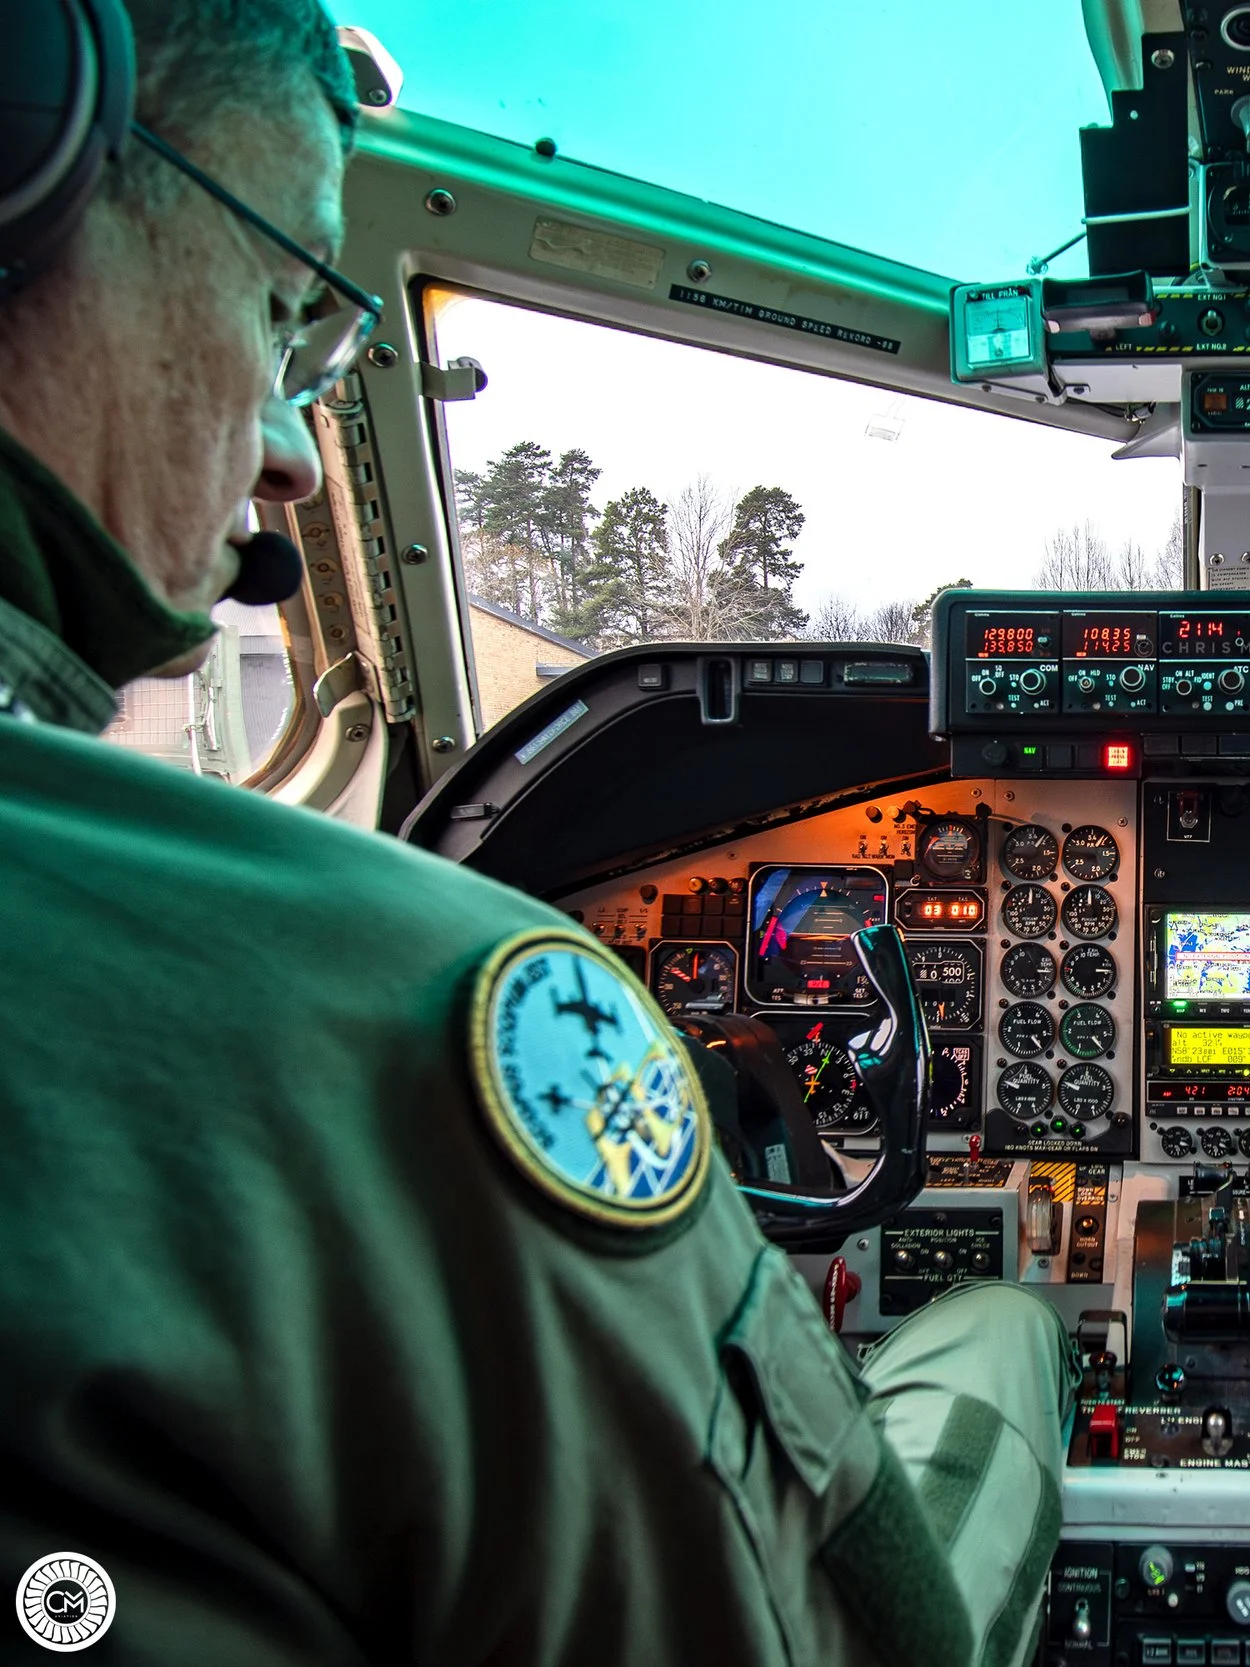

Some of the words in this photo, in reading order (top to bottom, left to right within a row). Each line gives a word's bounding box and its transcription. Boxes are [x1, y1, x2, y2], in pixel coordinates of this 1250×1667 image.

[759, 310, 797, 326] GROUND
[802, 321, 831, 334] SPEED
[1180, 620, 1223, 638] 2114
[1084, 628, 1130, 641] 108.35
[1084, 641, 1130, 653] 114.25
[1040, 664, 1058, 672] COM
[925, 905, 941, 915] 03
[951, 905, 977, 915] 010
[942, 967, 962, 976] 500
[1176, 1031, 1188, 1039] No
[1192, 1031, 1223, 1039] active
[1172, 1039, 1187, 1047] alt
[1073, 1079, 1101, 1087] QUANTITY
[1186, 1085, 1205, 1095] 421
[1227, 1085, 1250, 1096] 2:04
[904, 1229, 945, 1237] EXTERIOR
[945, 1229, 975, 1237] LIGHTS
[923, 1274, 943, 1282] FUEL
[946, 1274, 963, 1282] QTY
[1125, 1406, 1181, 1415] REVERSER
[1180, 1459, 1220, 1468] ENGINE
[1064, 1567, 1098, 1580] IGNITION
